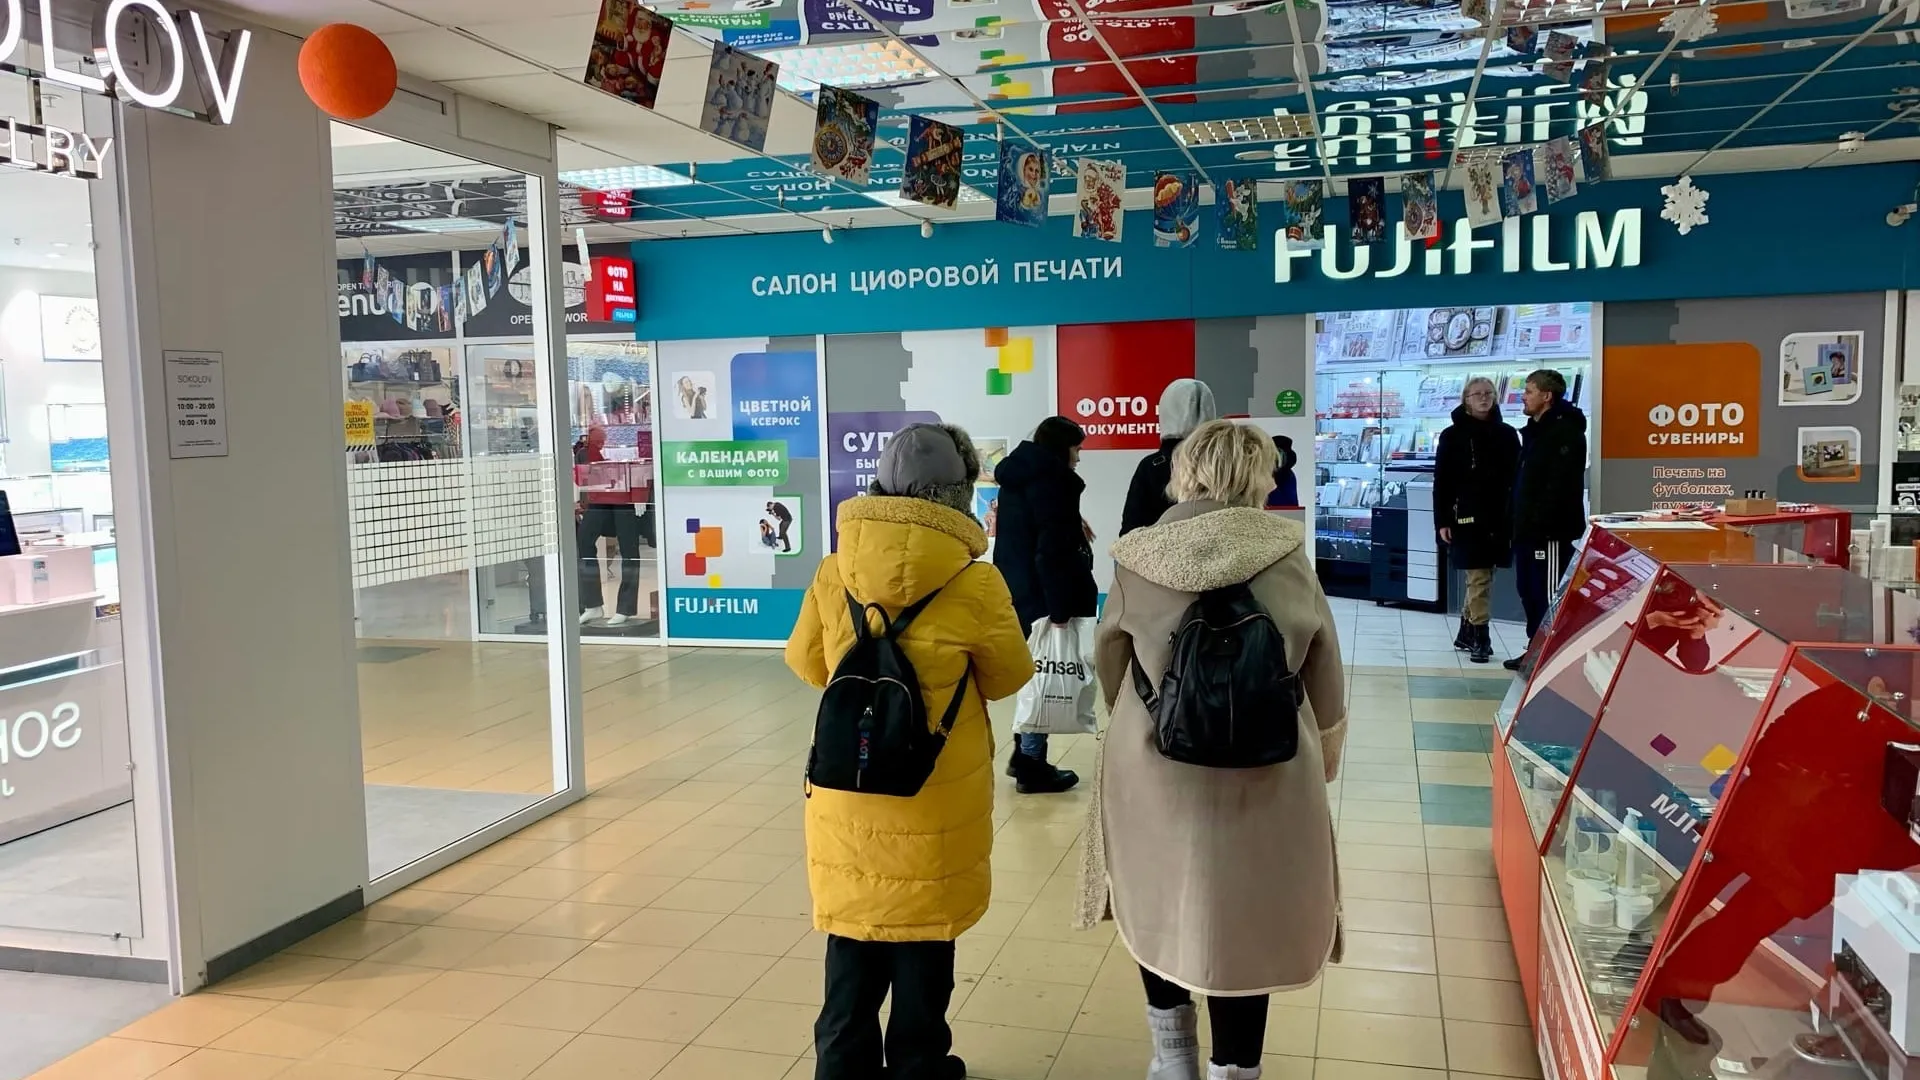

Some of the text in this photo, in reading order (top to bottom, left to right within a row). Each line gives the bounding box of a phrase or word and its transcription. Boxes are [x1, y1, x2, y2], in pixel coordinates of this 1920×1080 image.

[0, 0, 251, 124] LOV
[1274, 208, 1642, 284] FUJIFILM
[607, 265, 628, 279] ФОТО
[752, 257, 1122, 296] САЛОН ЦИФРОВОЙ ПЕЧАТИ
[740, 396, 812, 415] ЦВЕТНОЙ
[1076, 396, 1148, 417] ФОТО
[751, 416, 801, 427] КСЕРОКС
[1648, 402, 1745, 427] ФОТО
[1648, 432, 1744, 445] СУВЕНИРЫ
[676, 450, 779, 466] КАЛЕНДАРИ
[699, 469, 743, 478] ВАШИМ
[747, 468, 779, 478] ФОТО
[1652, 465, 1727, 479] Печать на
[1652, 482, 1735, 498] футболках,
[675, 597, 759, 614] FUJIFILM
[1034, 656, 1085, 681] sinsay
